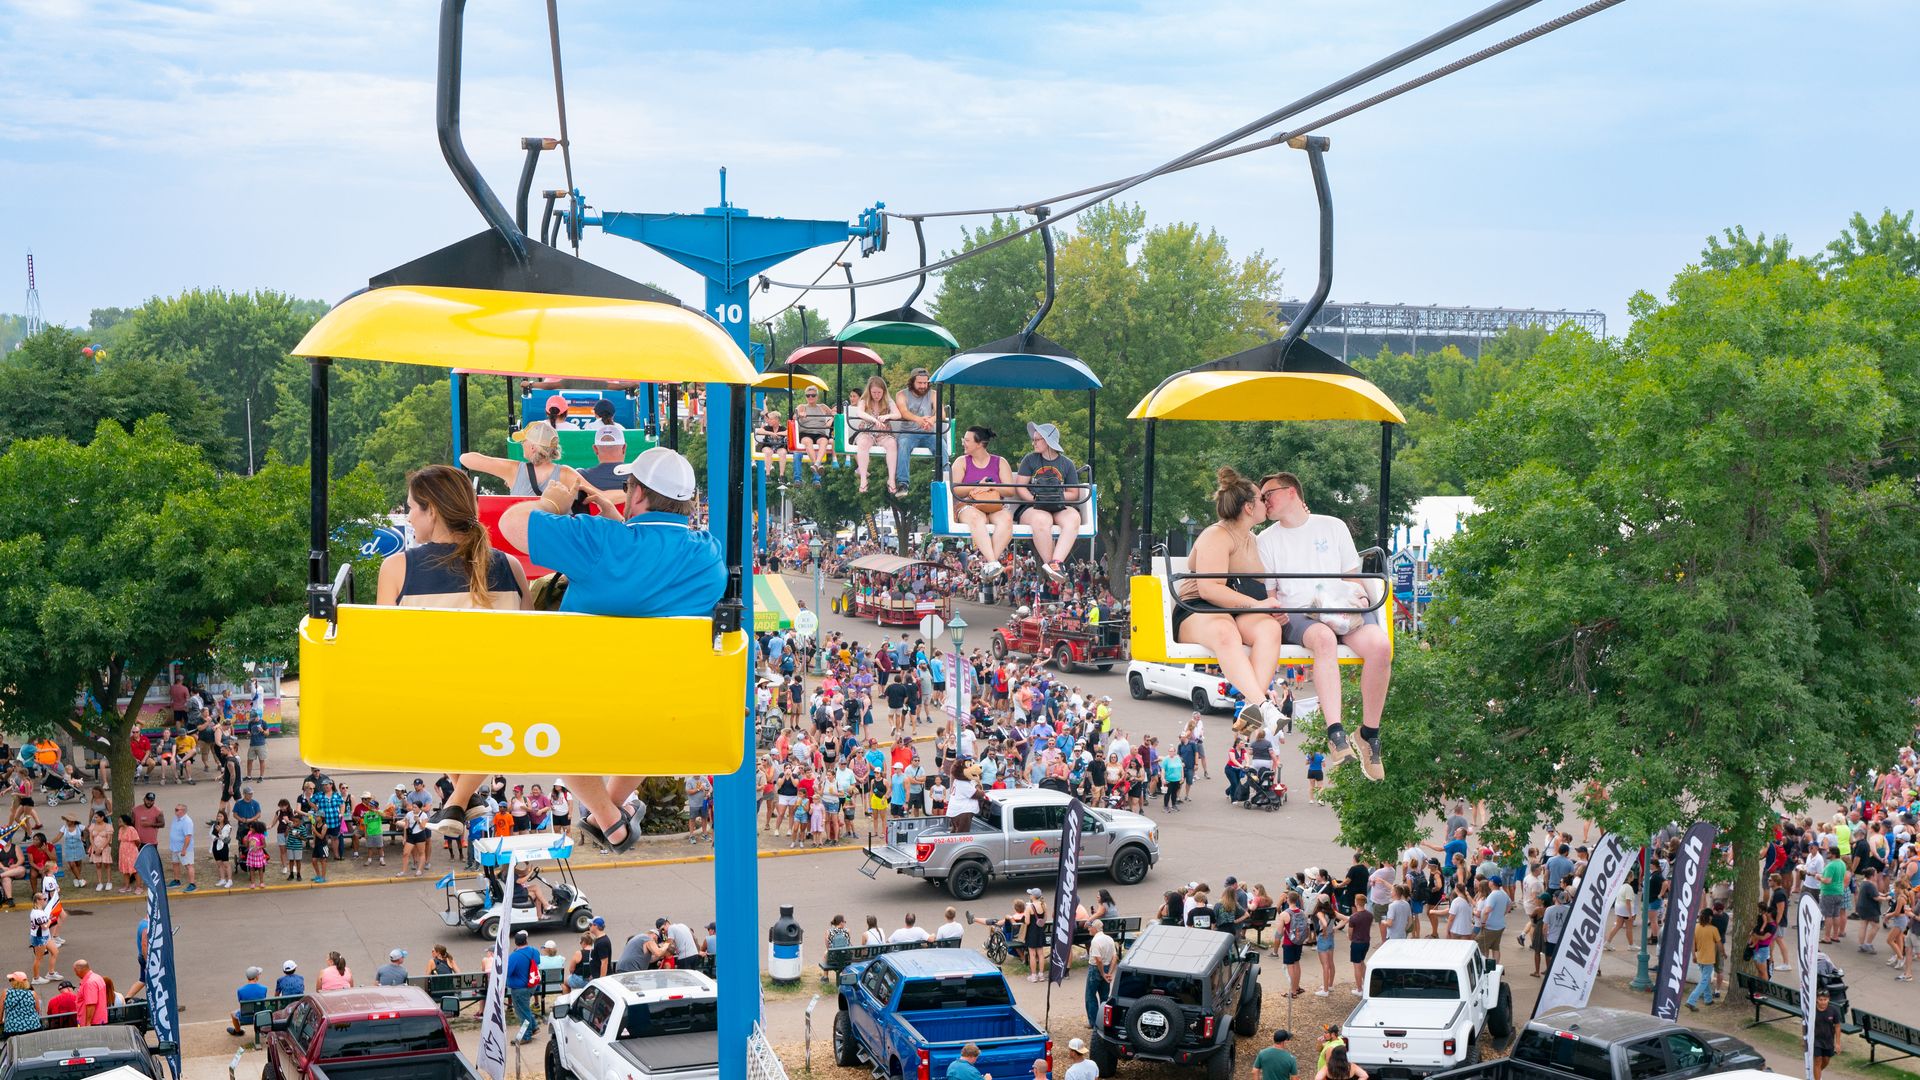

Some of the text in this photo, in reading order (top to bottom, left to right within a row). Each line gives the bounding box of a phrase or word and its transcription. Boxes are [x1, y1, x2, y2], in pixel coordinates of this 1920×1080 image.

[714, 303, 743, 324] 10
[478, 722, 562, 758] 30
[1566, 836, 1623, 969] Waldoch
[1382, 1040, 1408, 1050] Jeep
